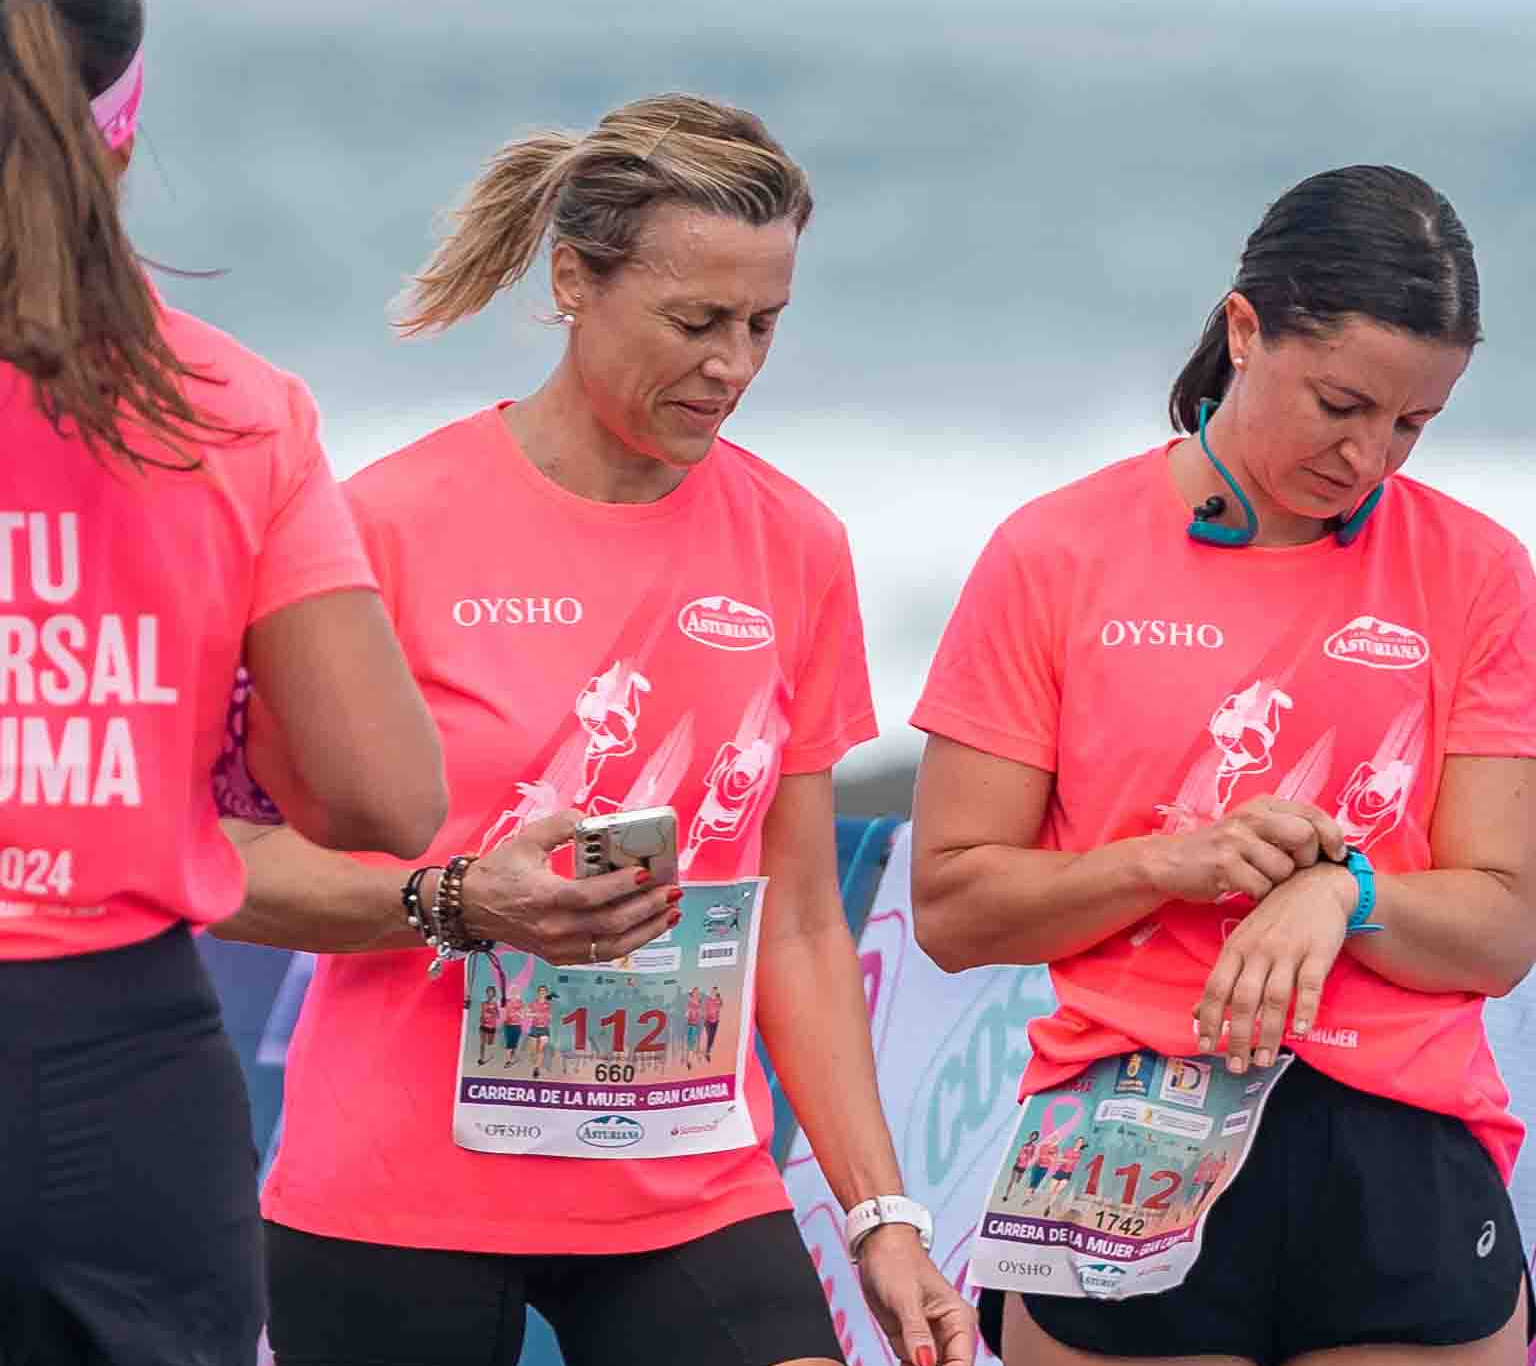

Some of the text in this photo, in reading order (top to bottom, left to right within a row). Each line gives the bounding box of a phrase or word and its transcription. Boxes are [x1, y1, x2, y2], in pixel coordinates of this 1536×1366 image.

[453, 596, 584, 627] OYSHO
[1101, 619, 1225, 649] OYSHO
[561, 1007, 669, 1053] 112
[594, 1064, 635, 1083] 660
[468, 1084, 536, 1103] CARRERA
[539, 1088, 561, 1104] DE
[564, 1089, 584, 1105] LA
[587, 1090, 636, 1107] MUJER
[647, 1088, 680, 1106] GRAN
[682, 1082, 729, 1102] CANARIA
[484, 1124, 542, 1139] OYSHO
[1084, 1154, 1182, 1211] 112
[1095, 1209, 1145, 1236] 1742
[988, 1220, 1045, 1242] CARRERA
[1048, 1229, 1069, 1243] DE
[1068, 1230, 1083, 1249] LA
[1086, 1236, 1134, 1258] MUJER
[998, 1259, 1053, 1277] OYSHO
